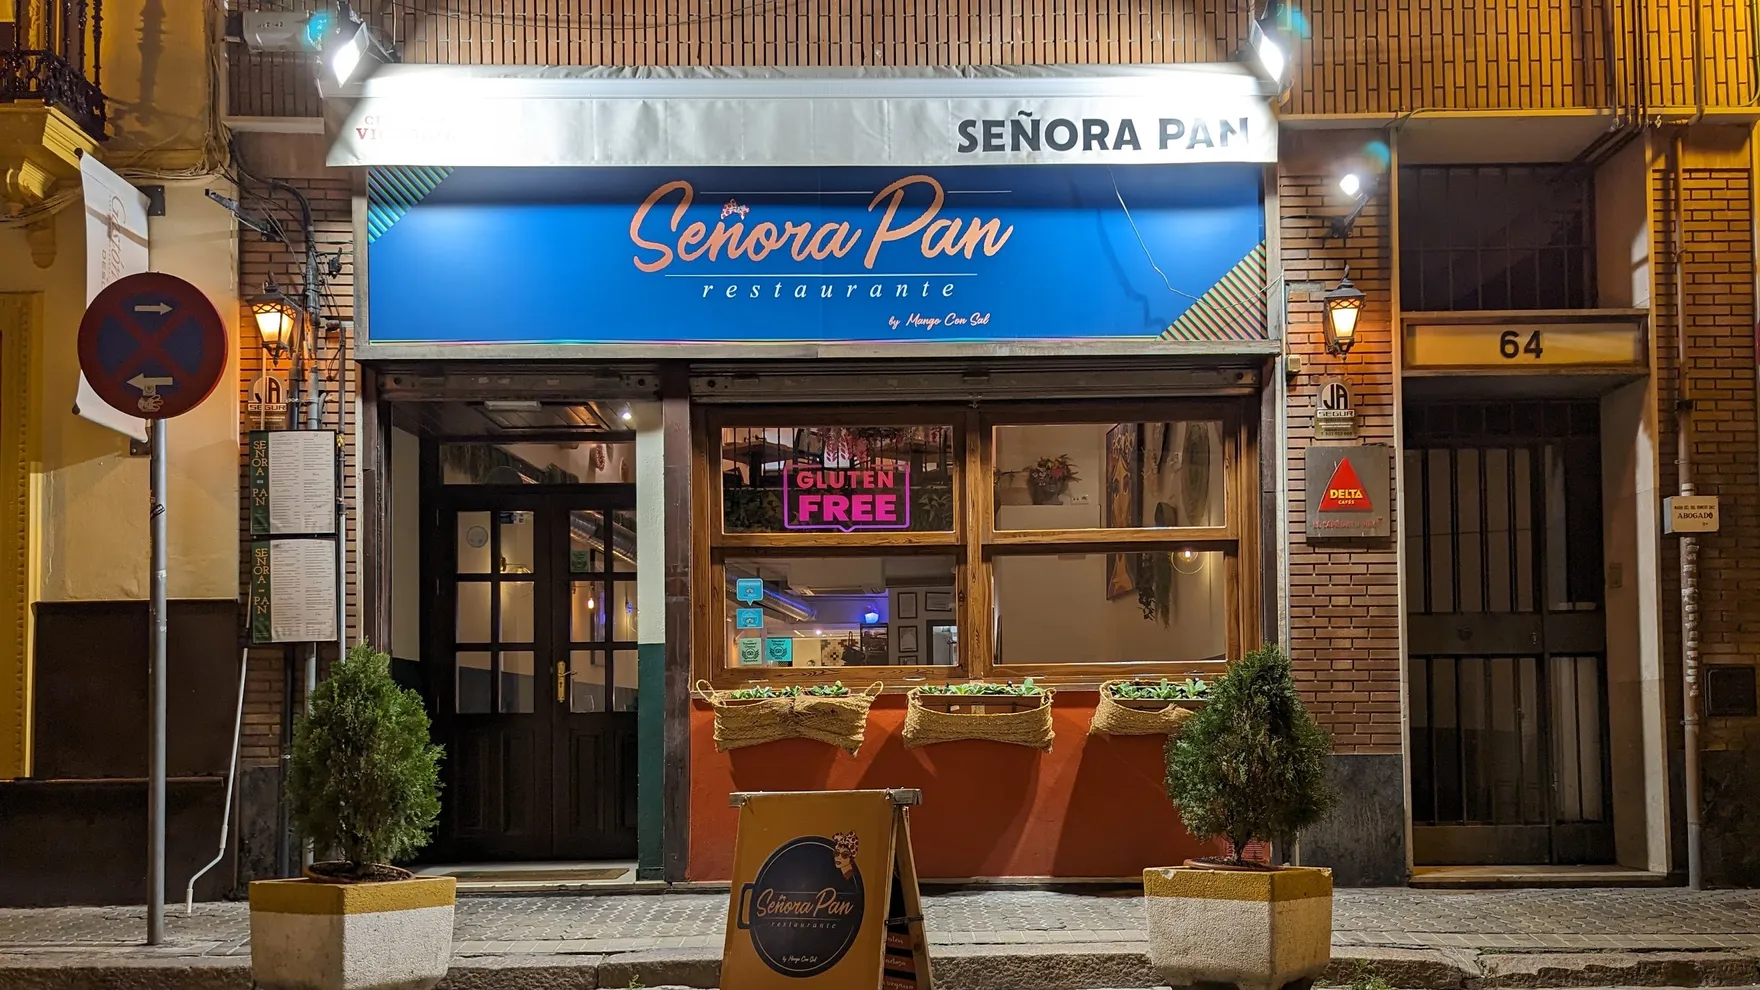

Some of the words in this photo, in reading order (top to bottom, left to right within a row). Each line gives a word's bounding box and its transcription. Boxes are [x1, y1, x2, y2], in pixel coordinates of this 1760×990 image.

[957, 110, 1142, 153] SEÑORA
[1158, 116, 1249, 150] PAN
[629, 179, 863, 273] Señora
[863, 174, 1014, 270] Pan
[702, 281, 955, 299] restaurante
[888, 315, 901, 330] by
[905, 312, 942, 328] Mango
[943, 312, 968, 326] Con
[969, 311, 991, 326] Sal
[1500, 330, 1544, 359] 64
[1323, 383, 1349, 410] JA
[796, 470, 895, 489] GLUTEN
[1329, 488, 1364, 499] DELTA
[798, 494, 897, 522] FREE
[756, 888, 814, 917] Señora
[813, 887, 854, 918] Pan
[771, 921, 837, 929] restaurante
